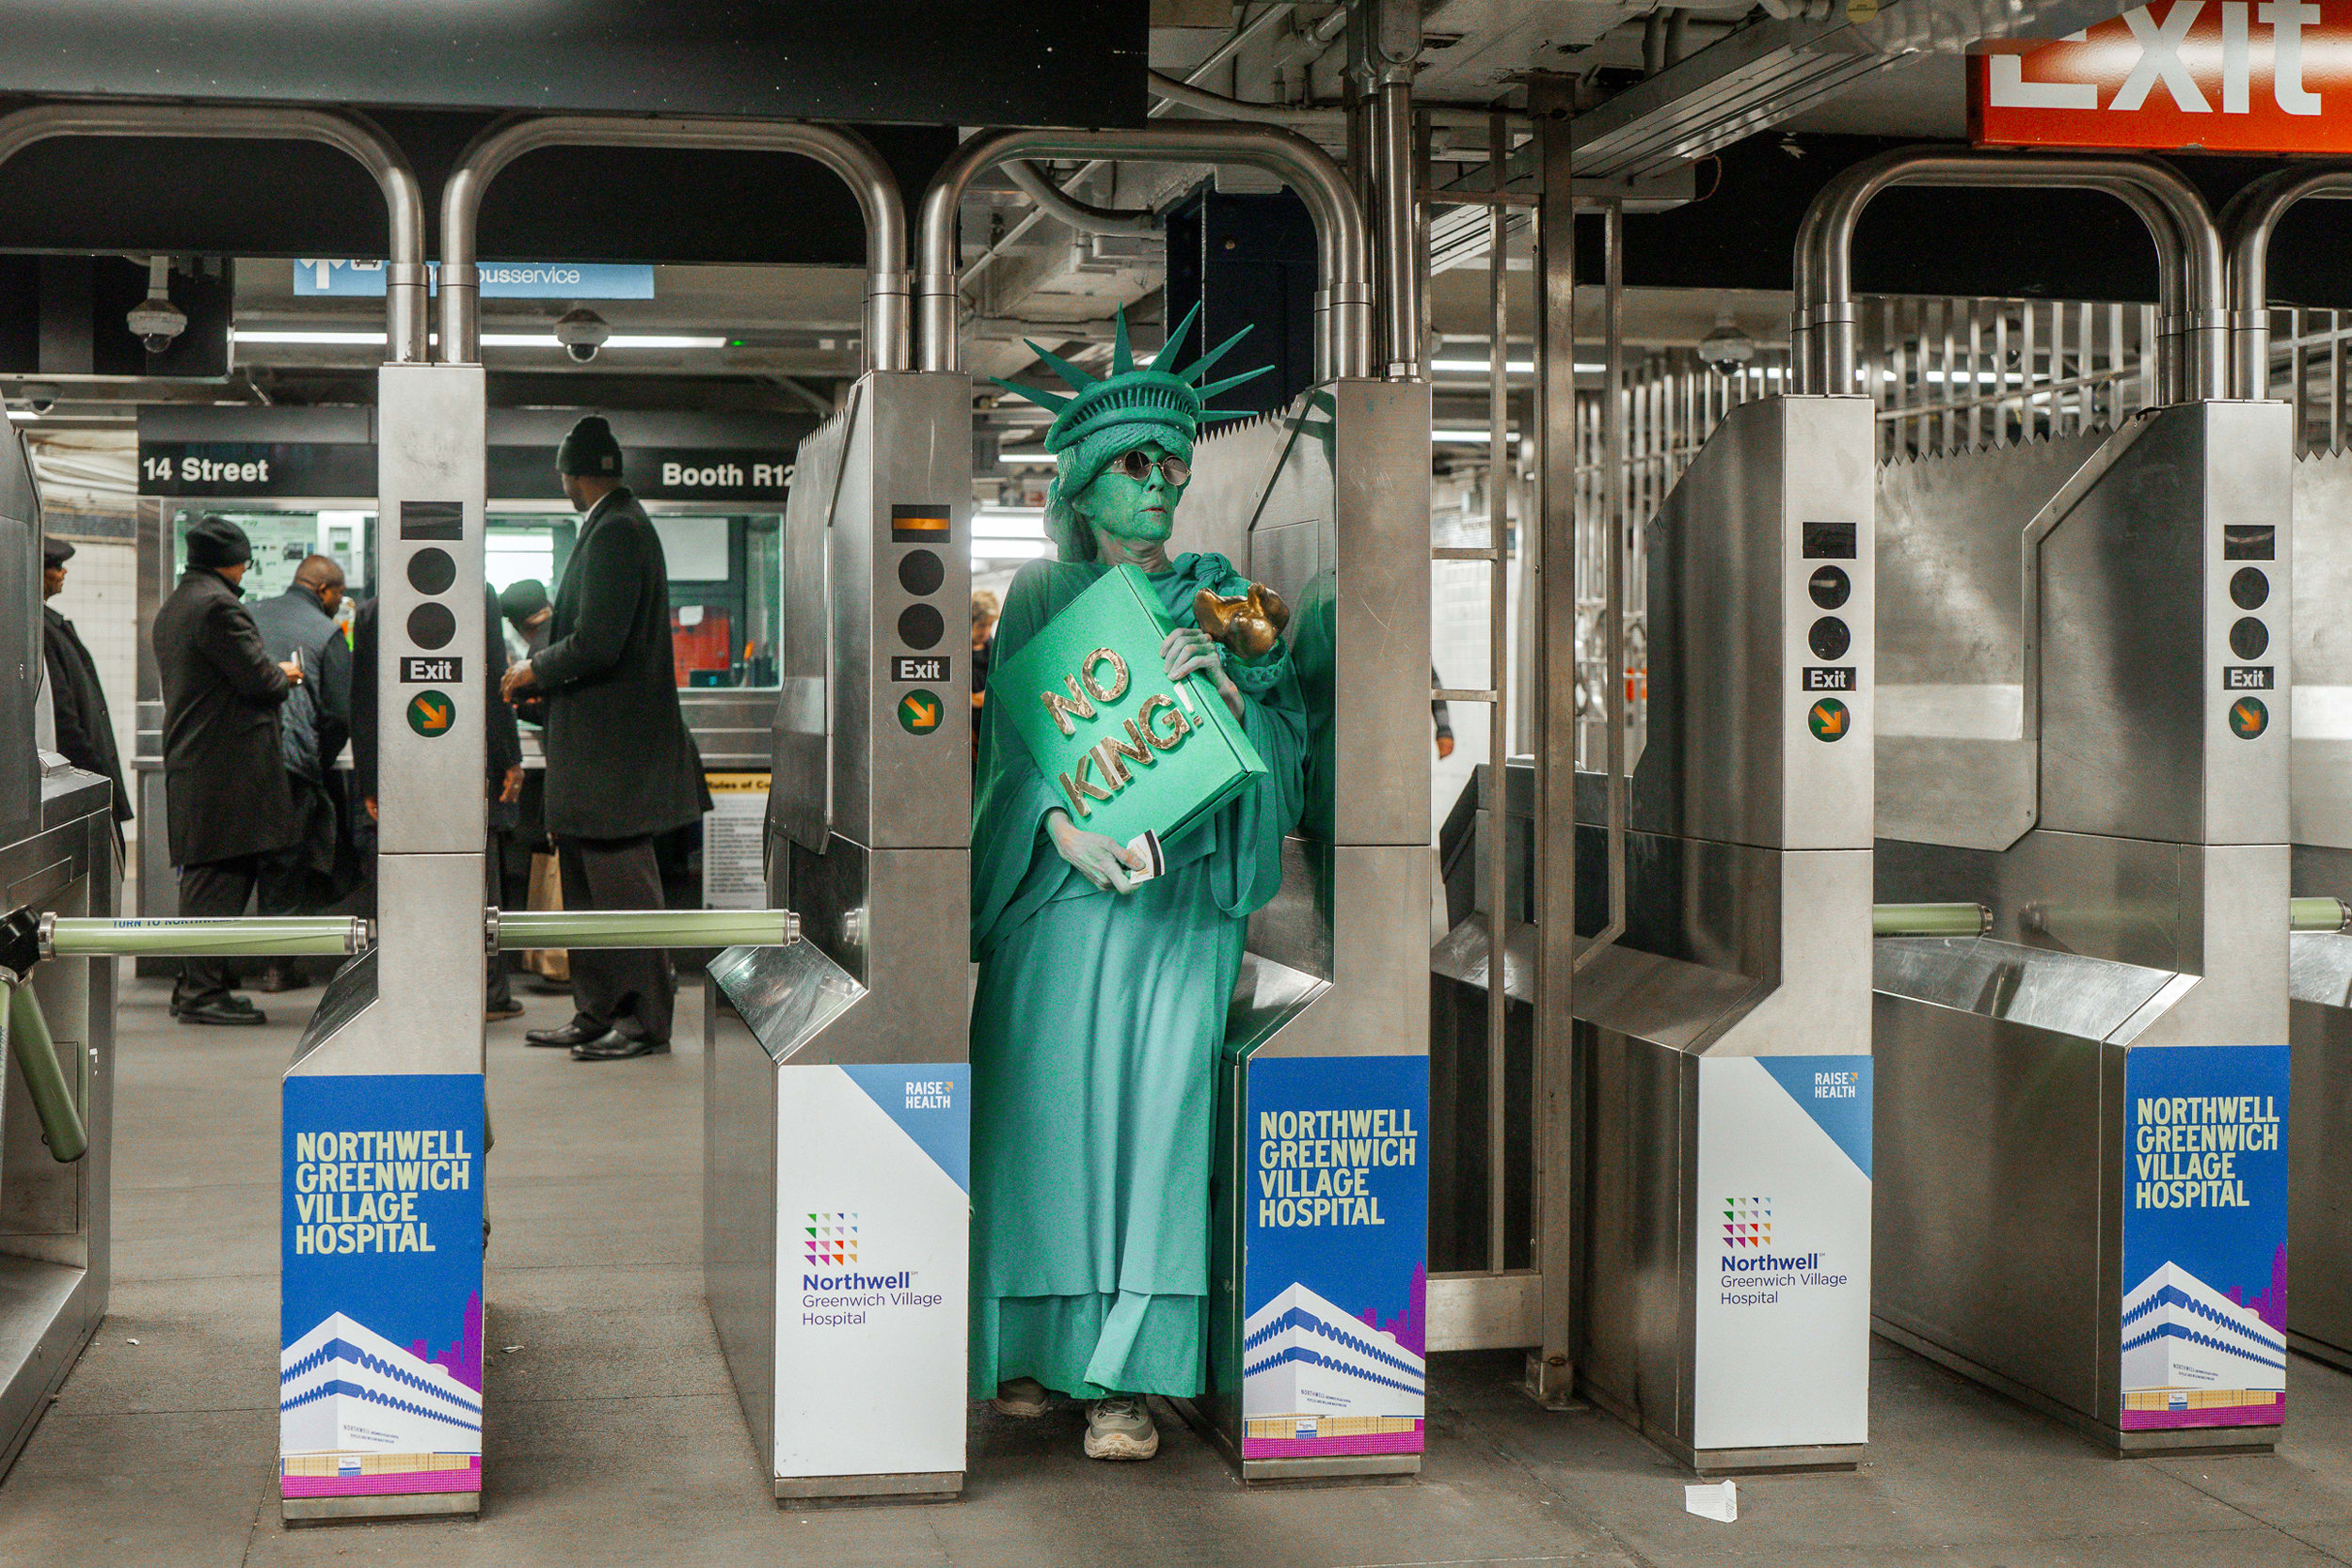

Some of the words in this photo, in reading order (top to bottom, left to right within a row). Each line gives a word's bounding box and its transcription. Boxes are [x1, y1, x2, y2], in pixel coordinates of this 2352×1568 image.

[143, 457, 173, 481] 14
[182, 457, 269, 482] Street
[662, 462, 744, 486] Booth
[410, 660, 452, 679] Exit
[900, 660, 940, 678] Exit
[1811, 671, 1846, 688] Exit
[2231, 670, 2265, 687] Exit
[1040, 647, 1129, 736] NO
[906, 1082, 943, 1095] RAISE
[1815, 1072, 1849, 1085] RAISE
[905, 1096, 951, 1109] HEALTH
[1815, 1085, 1855, 1099] HEALTH
[2137, 1096, 2280, 1125] NORTHWELL
[1260, 1109, 1418, 1139] NORTHWELL
[296, 1131, 471, 1162] NORTHWELL
[2137, 1124, 2278, 1153] GREENWICH
[1259, 1138, 1415, 1169] GREENWICH
[295, 1161, 469, 1193] GREENWICH
[2136, 1152, 2236, 1180] VILLAGE
[1259, 1168, 1370, 1198] VILLAGE
[2136, 1180, 2249, 1209] HOSPITAL
[294, 1192, 418, 1223] VILLAGE
[1259, 1196, 1385, 1227] HOSPITAL
[295, 1223, 436, 1254] HOSPITAL
[1722, 1253, 1818, 1272] Northwell
[803, 1272, 910, 1291] Northwell
[1721, 1274, 1796, 1288] Greenwich
[1800, 1273, 1848, 1287] Village
[803, 1292, 885, 1307] Greenwich
[890, 1292, 942, 1307] Village
[1721, 1291, 1778, 1306] Hospital
[803, 1311, 866, 1327] Hospital
